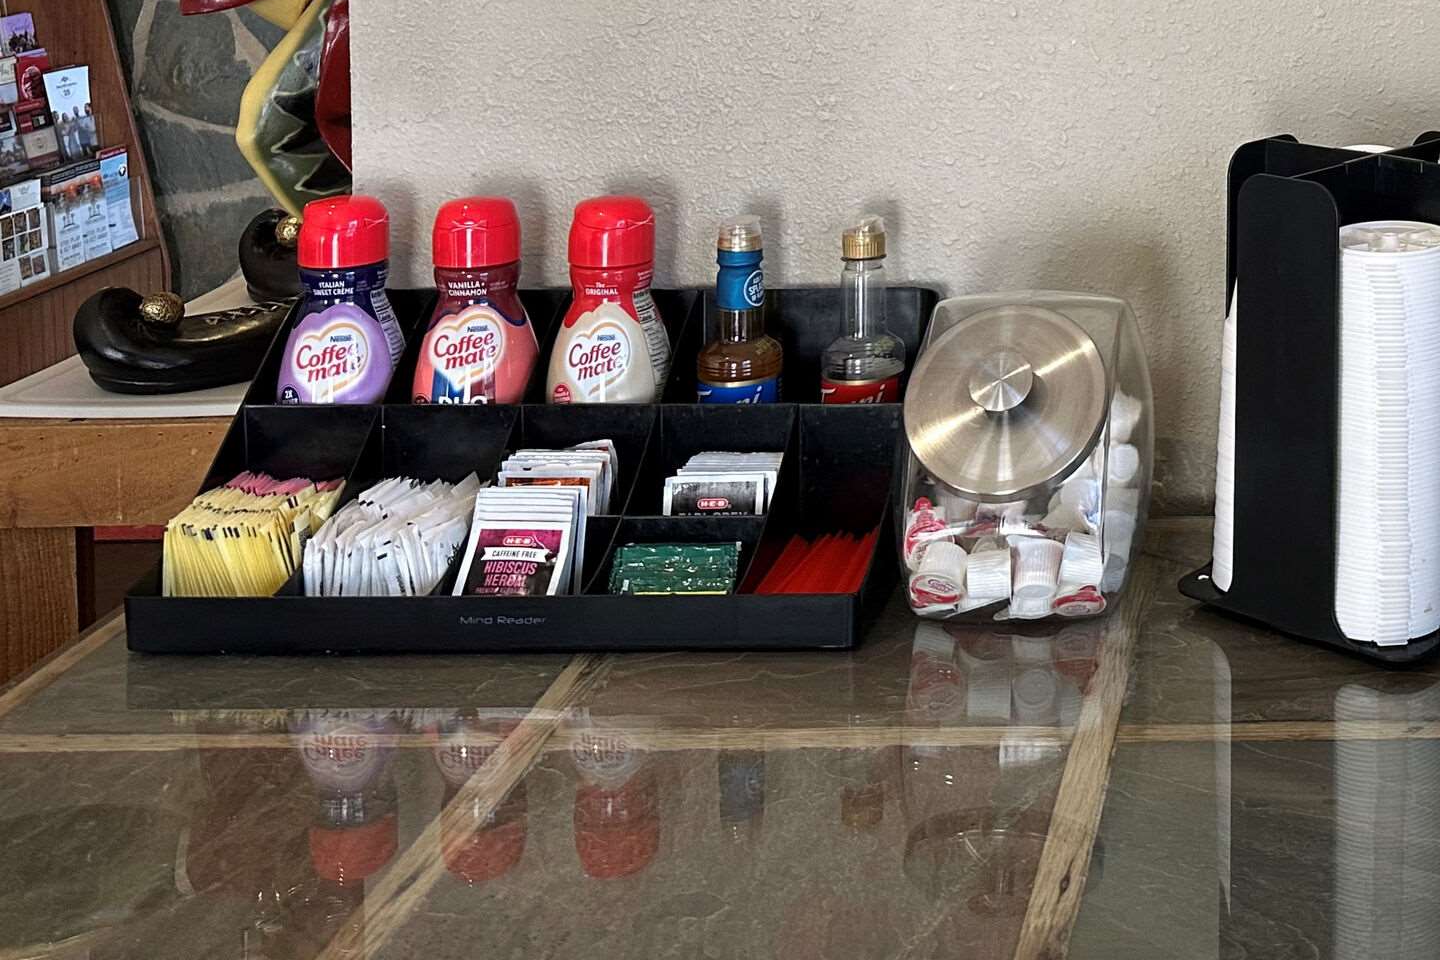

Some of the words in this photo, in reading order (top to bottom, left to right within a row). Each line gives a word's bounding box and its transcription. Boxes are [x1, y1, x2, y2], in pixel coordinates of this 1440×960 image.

[585, 288, 618, 296] ORIGINAL
[434, 332, 494, 358] Coffee
[445, 344, 497, 370] mate
[569, 342, 621, 368] Coffee
[492, 550, 519, 558] CAFFEINE
[521, 550, 537, 558] FREE
[484, 561, 538, 575] HIBISCUS
[460, 615, 493, 625] Mind
[497, 615, 546, 625] Reader
